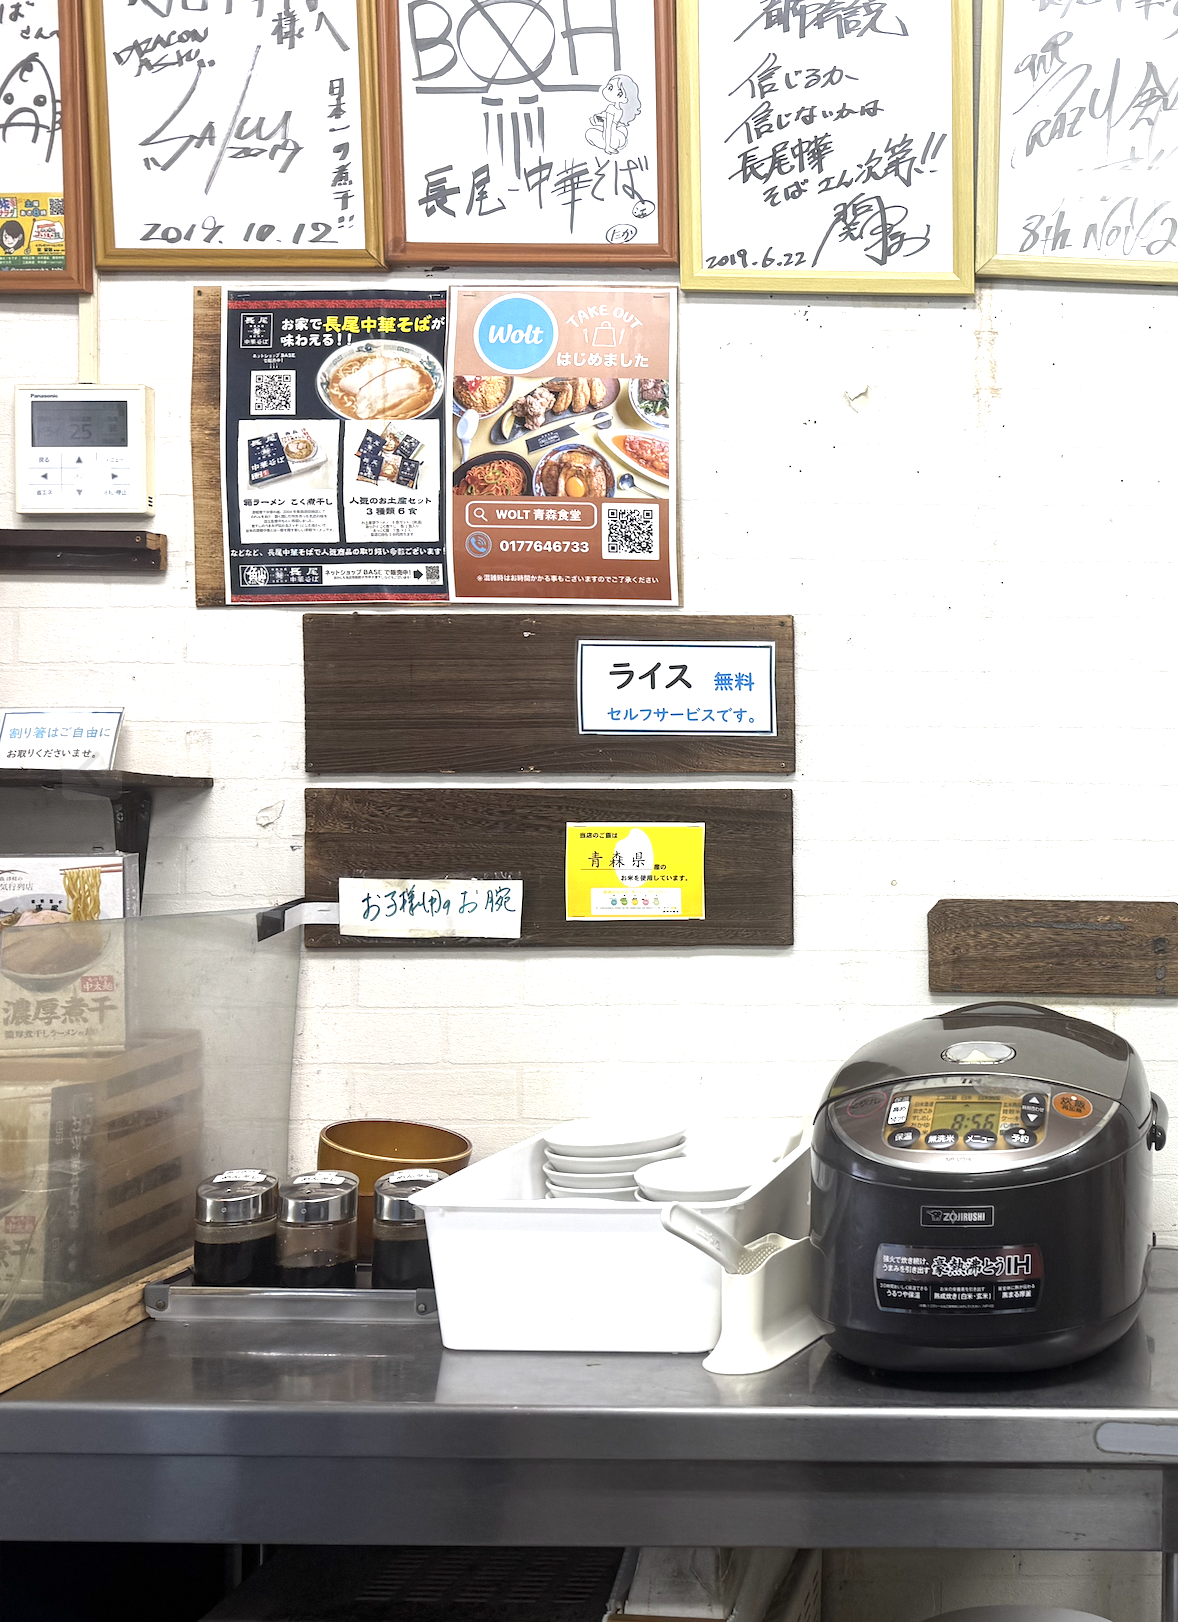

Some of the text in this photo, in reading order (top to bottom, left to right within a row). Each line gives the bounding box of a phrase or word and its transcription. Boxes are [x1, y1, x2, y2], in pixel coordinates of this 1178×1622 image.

[281, 314, 446, 333] お家で長尾中華そばが
[565, 304, 643, 329] TAKE OUT
[488, 324, 544, 345] Wolt
[556, 352, 649, 368] はじめました
[496, 508, 582, 522] WOLT 青森食堂
[499, 539, 590, 554] 0177646733
[609, 662, 755, 692] ライス 無料
[606, 707, 755, 724] セルフサービスです。
[8, 726, 111, 740] 割り箸はご自由に
[6, 748, 97, 759] お取りくださいませ。
[587, 850, 646, 869] 青森県
[2, 996, 118, 1027] 濃厚煮干
[950, 1113, 997, 1132] 8:56
[964, 1134, 996, 1145] メニュー
[942, 1209, 986, 1225] ZOJIRUSHI
